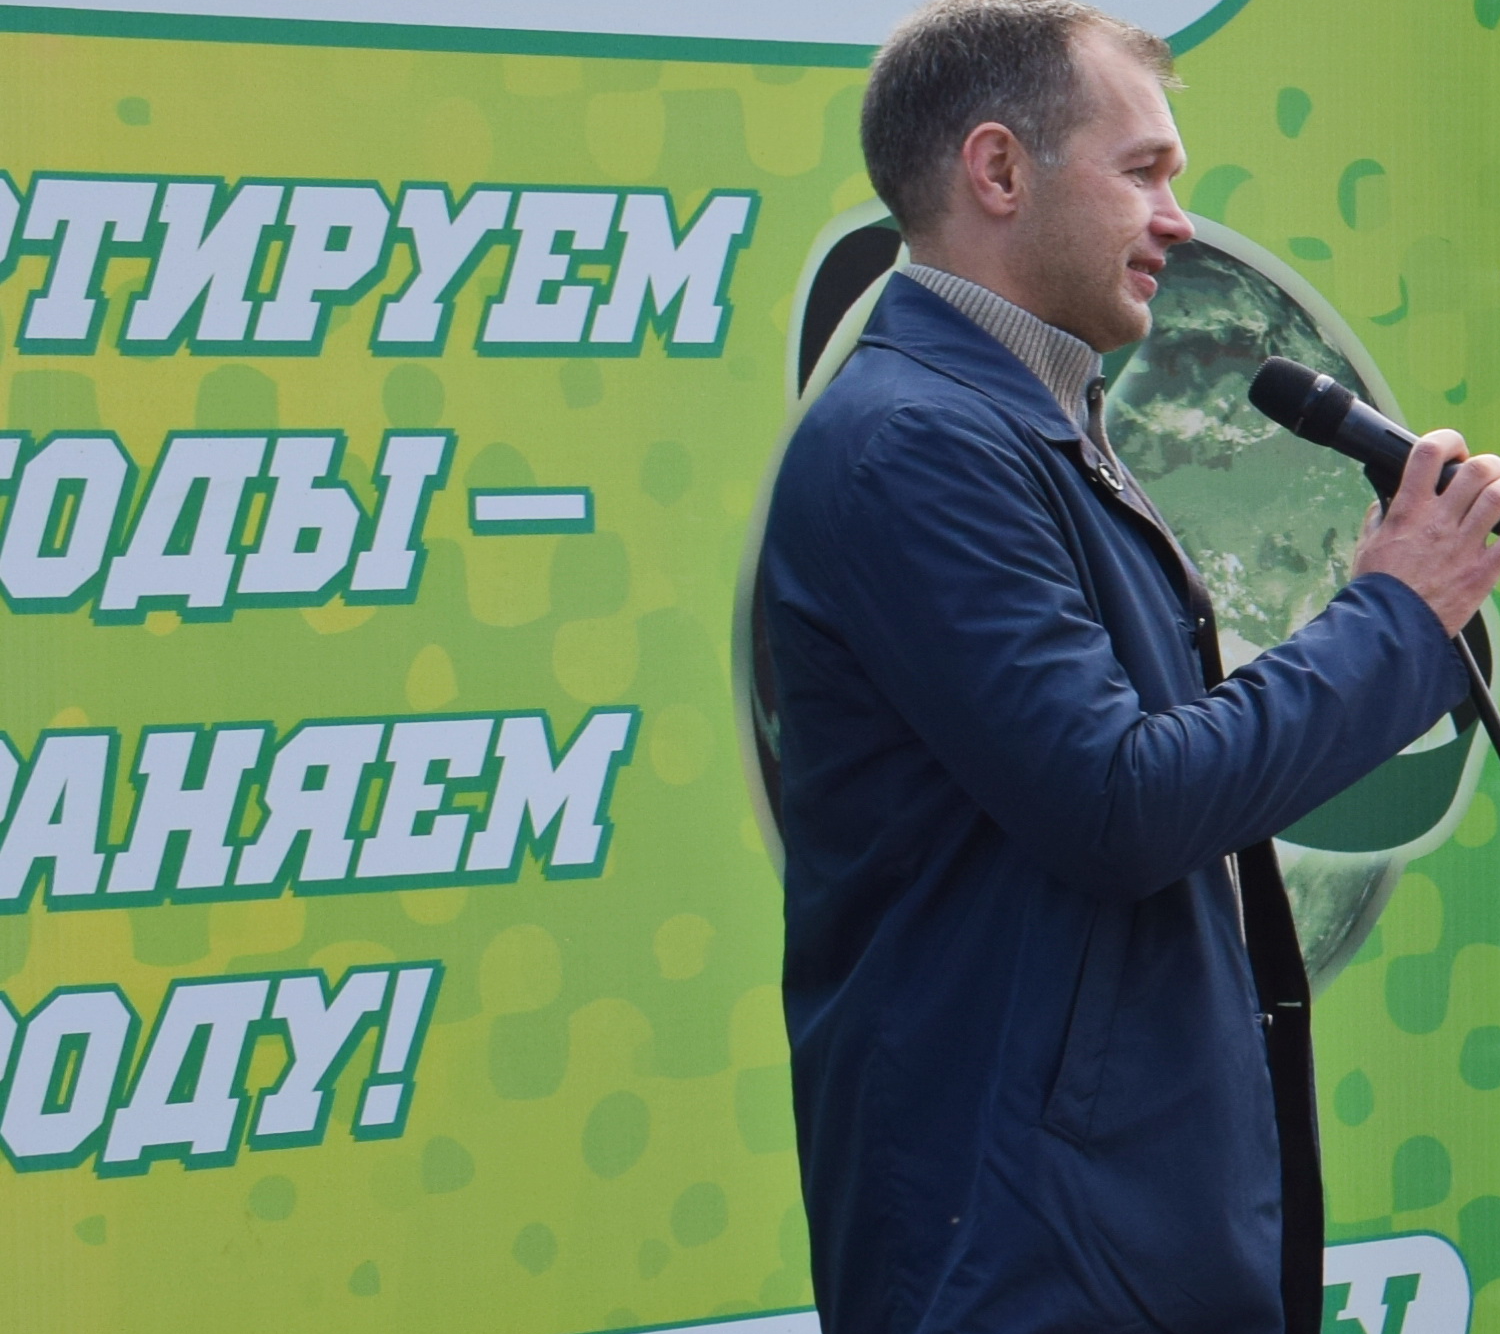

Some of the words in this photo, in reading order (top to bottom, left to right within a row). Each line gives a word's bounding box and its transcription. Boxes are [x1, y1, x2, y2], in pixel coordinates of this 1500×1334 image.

[0, 172, 760, 357] ТИРУЕМ
[0, 429, 458, 625] ОДЫ
[0, 705, 642, 915] АНЯЕМ
[0, 960, 446, 1179] ОДУ!
